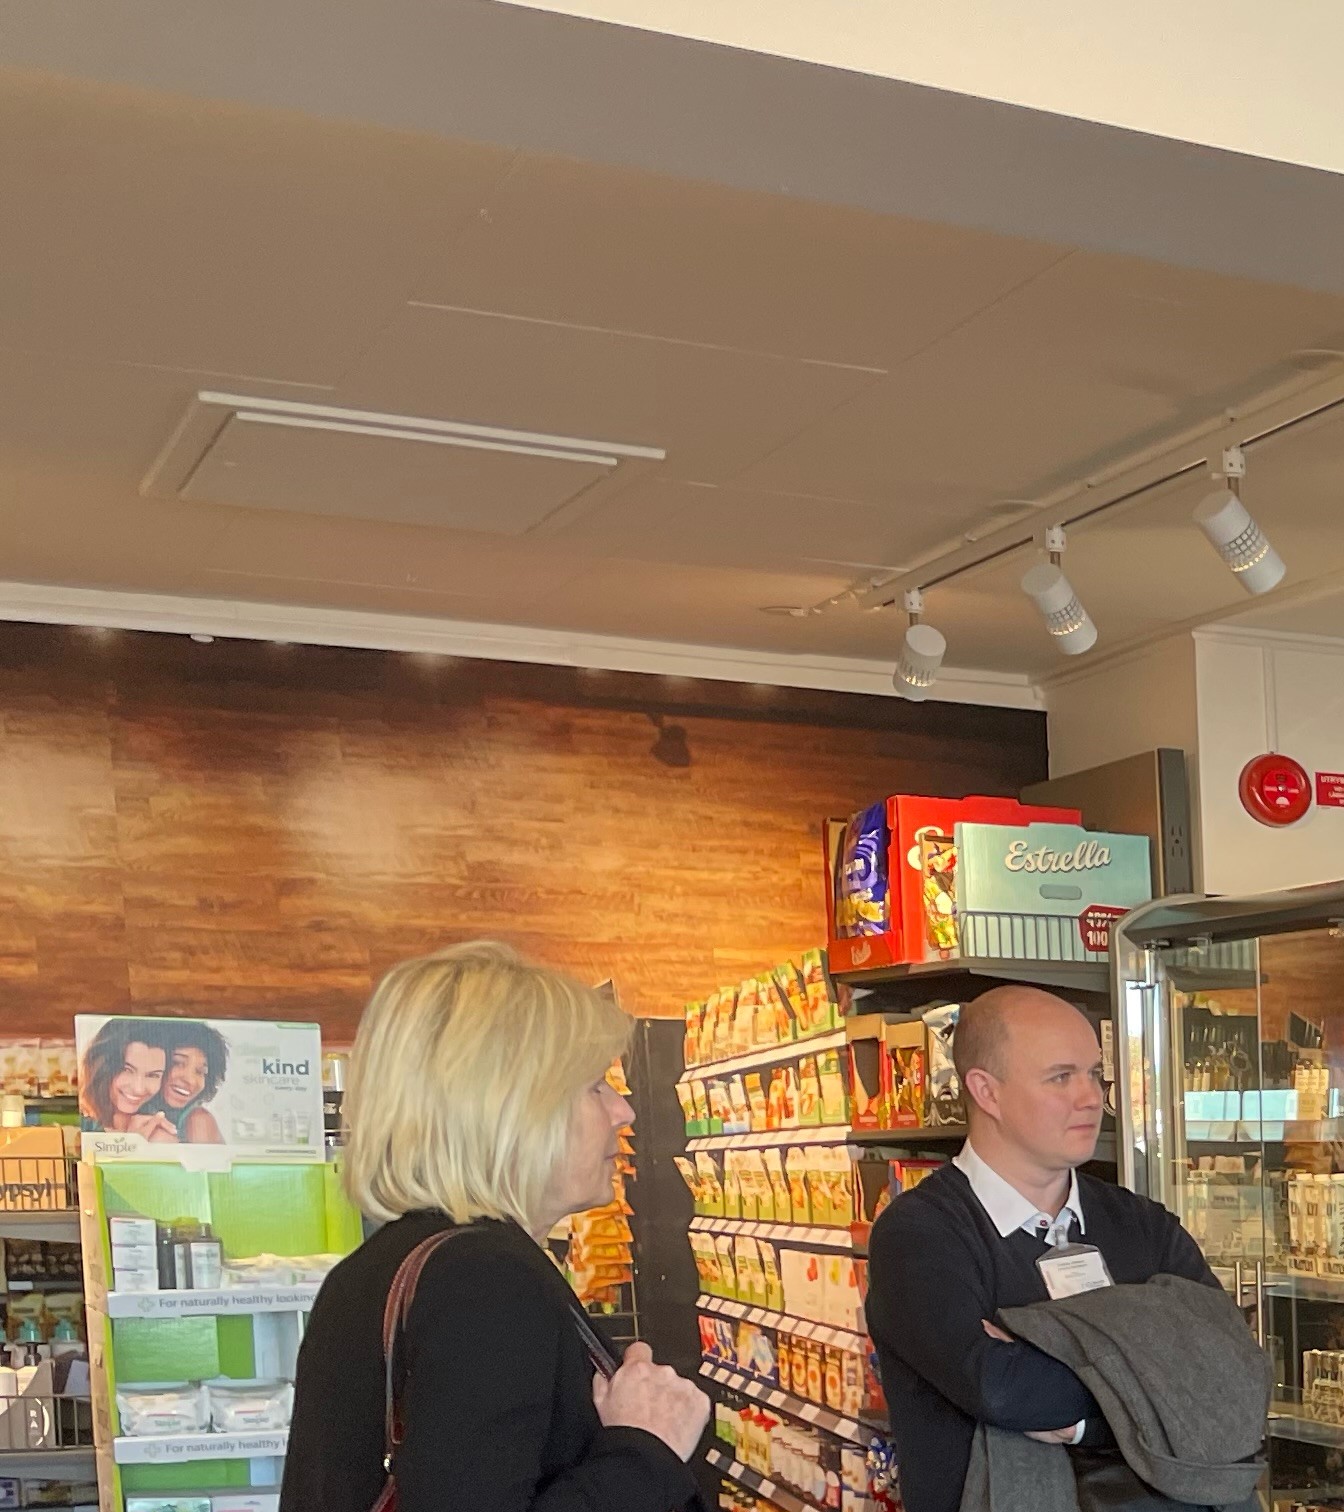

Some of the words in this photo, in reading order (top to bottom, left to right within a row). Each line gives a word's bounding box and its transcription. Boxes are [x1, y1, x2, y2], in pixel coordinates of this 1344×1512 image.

[1004, 840, 1112, 874] Estrella
[262, 1058, 310, 1076] kind
[159, 1297, 177, 1309] For
[179, 1296, 229, 1310] naturally
[232, 1294, 273, 1307] healthy
[165, 1443, 184, 1454] For
[186, 1441, 235, 1455] naturally
[238, 1439, 279, 1452] healthy
